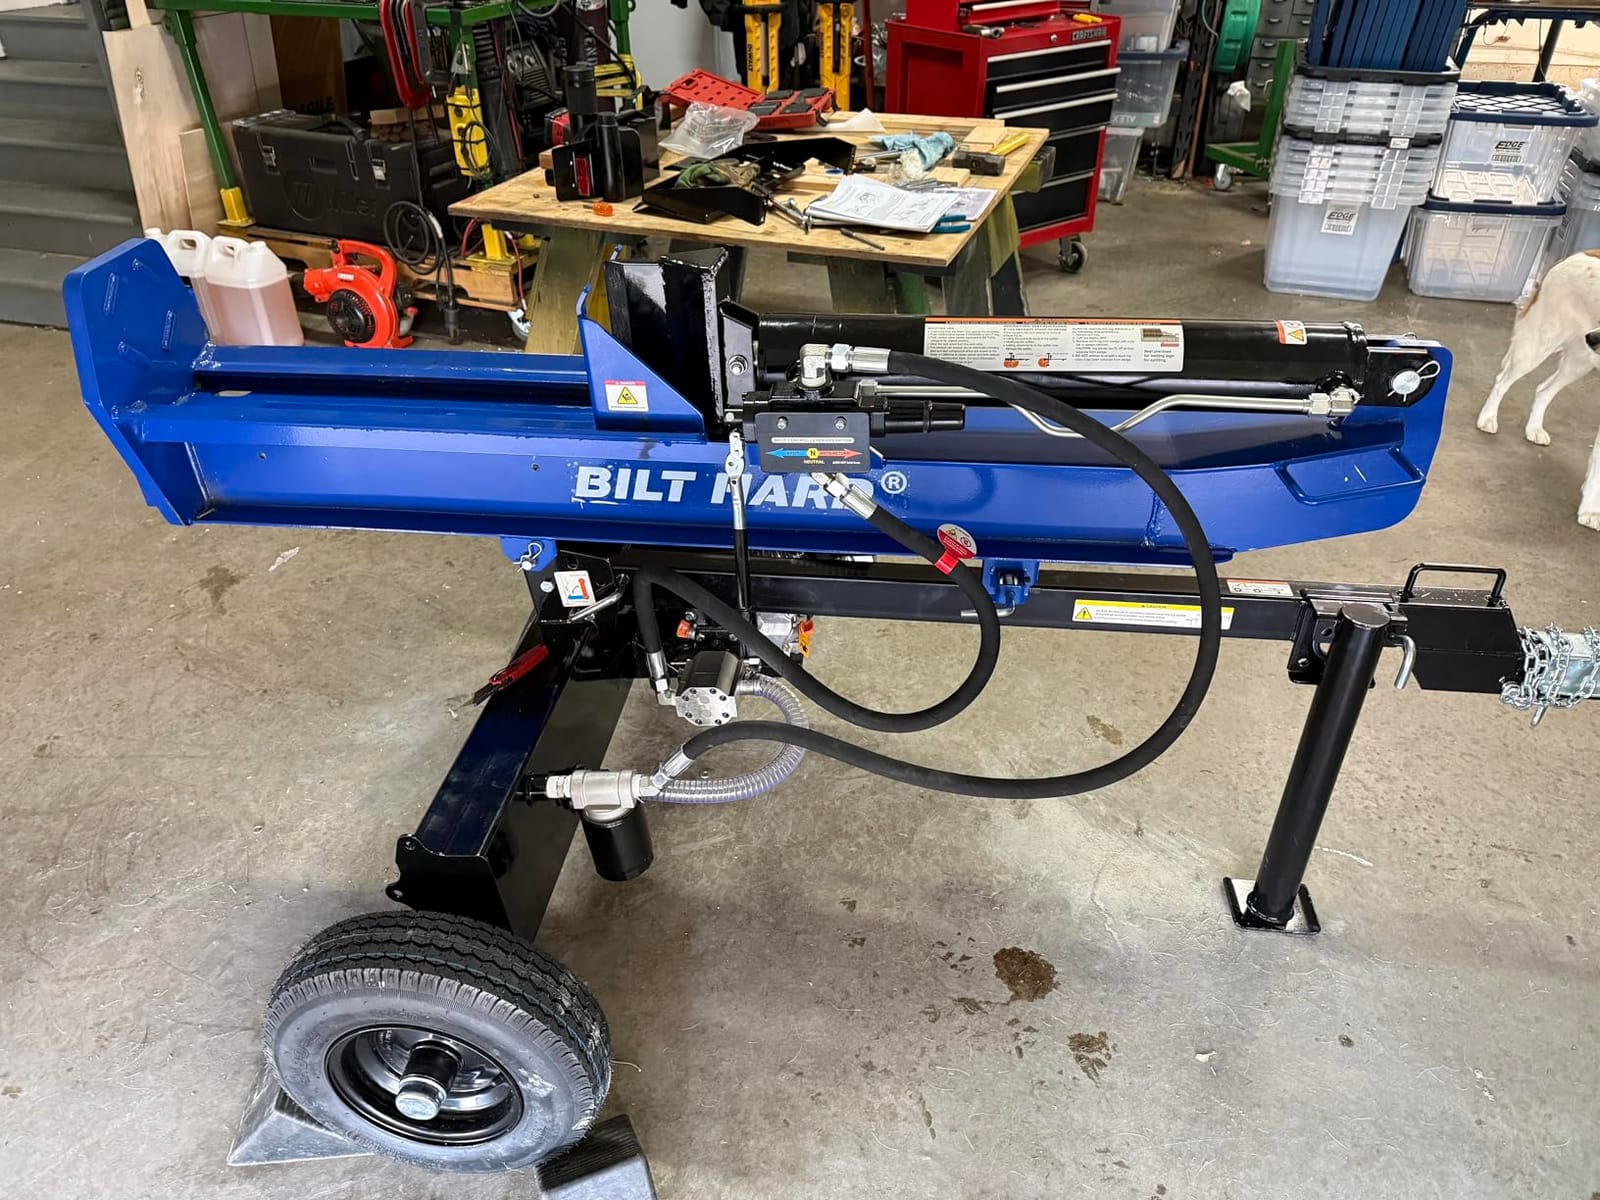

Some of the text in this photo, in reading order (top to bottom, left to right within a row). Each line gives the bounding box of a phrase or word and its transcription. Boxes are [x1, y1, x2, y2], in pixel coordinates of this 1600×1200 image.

[1494, 140, 1528, 150] EDGE
[1326, 211, 1356, 221] EDGE
[575, 466, 697, 503] BILT
